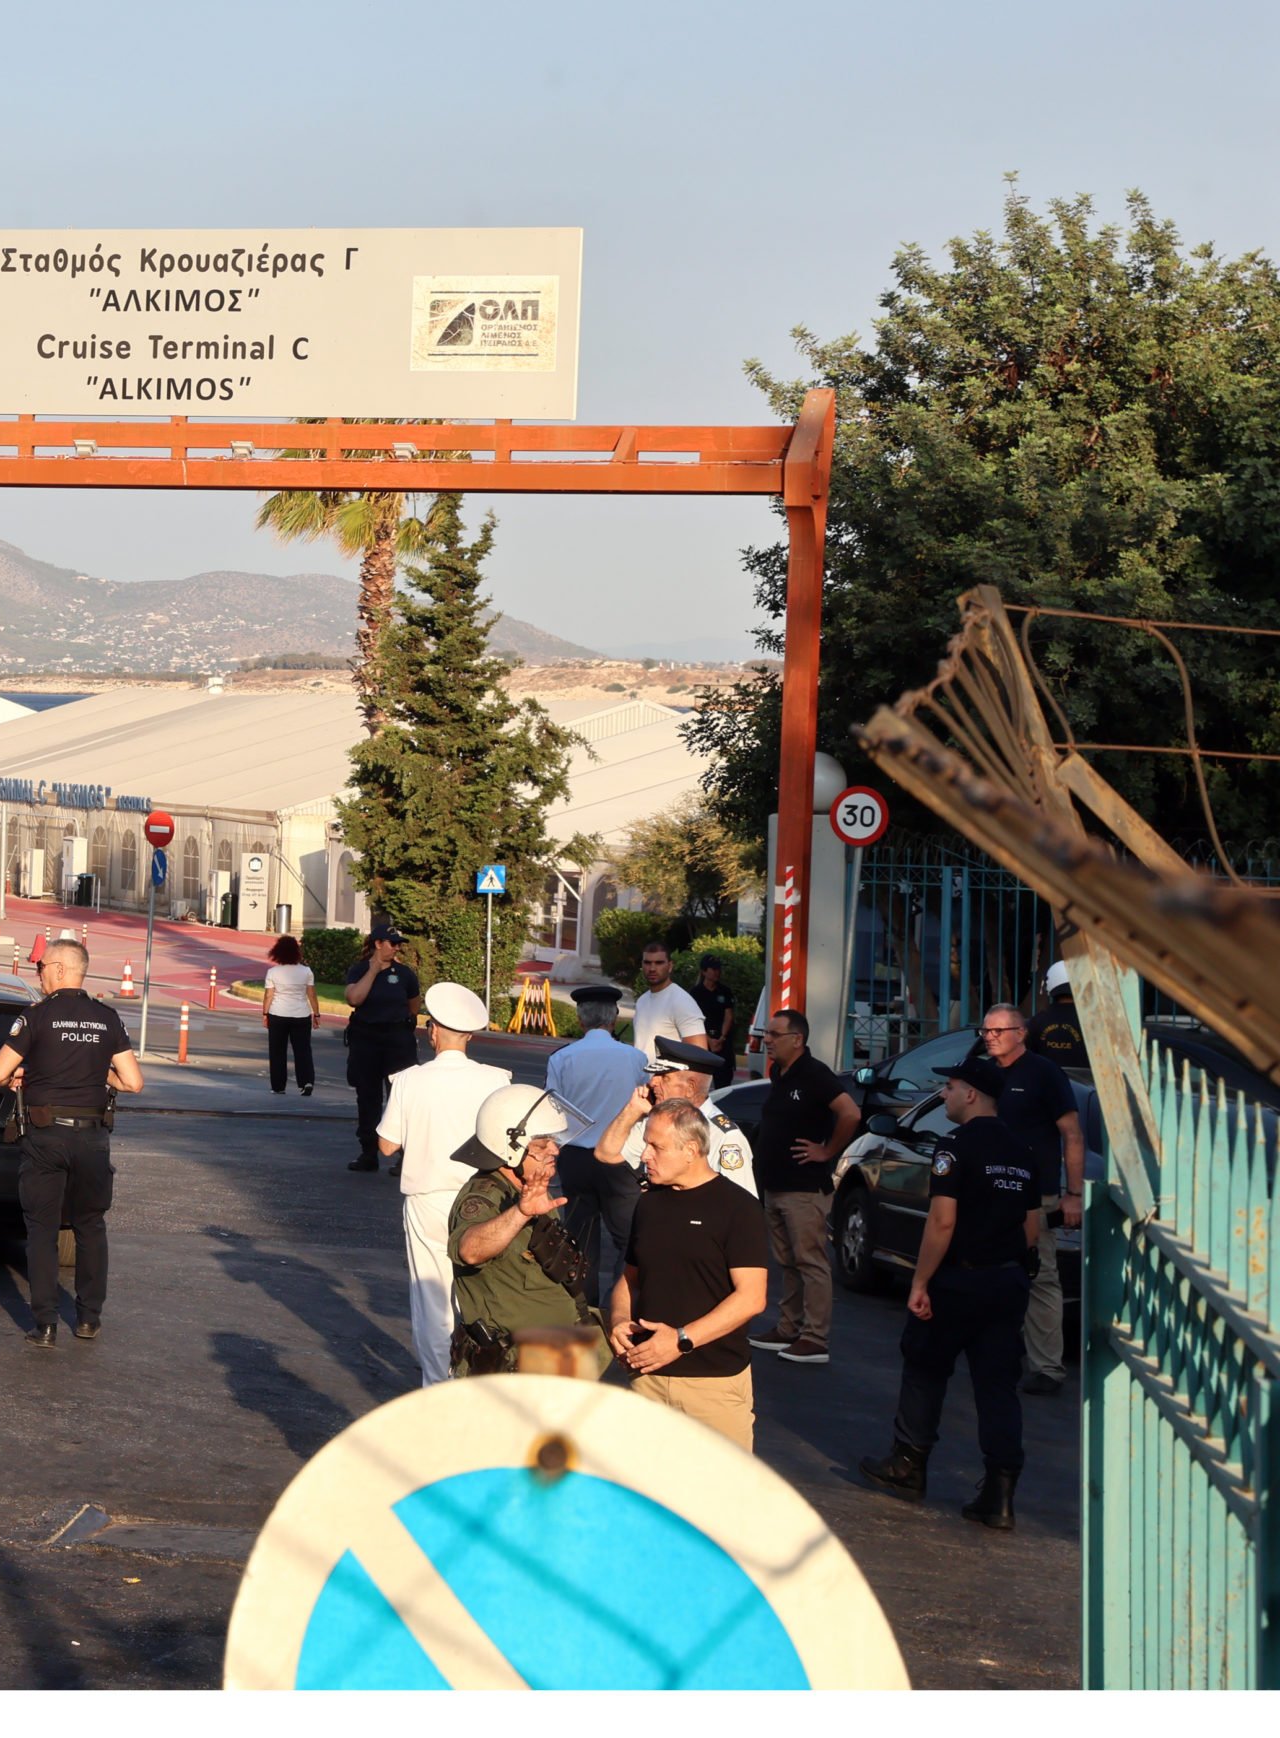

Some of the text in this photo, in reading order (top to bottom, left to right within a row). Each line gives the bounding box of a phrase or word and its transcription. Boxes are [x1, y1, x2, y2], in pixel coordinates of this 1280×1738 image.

[0, 243, 122, 278] Σταθμός
[140, 242, 325, 278] Κρουαζιέρας
[478, 299, 540, 321] ΟΛΠ
[36, 333, 310, 361] Cruise Terminal C
[86, 376, 252, 401] "ALKIMOS"
[842, 804, 876, 828] 30
[61, 1032, 100, 1043] POLICE
[992, 1178, 1024, 1192] POLICE
